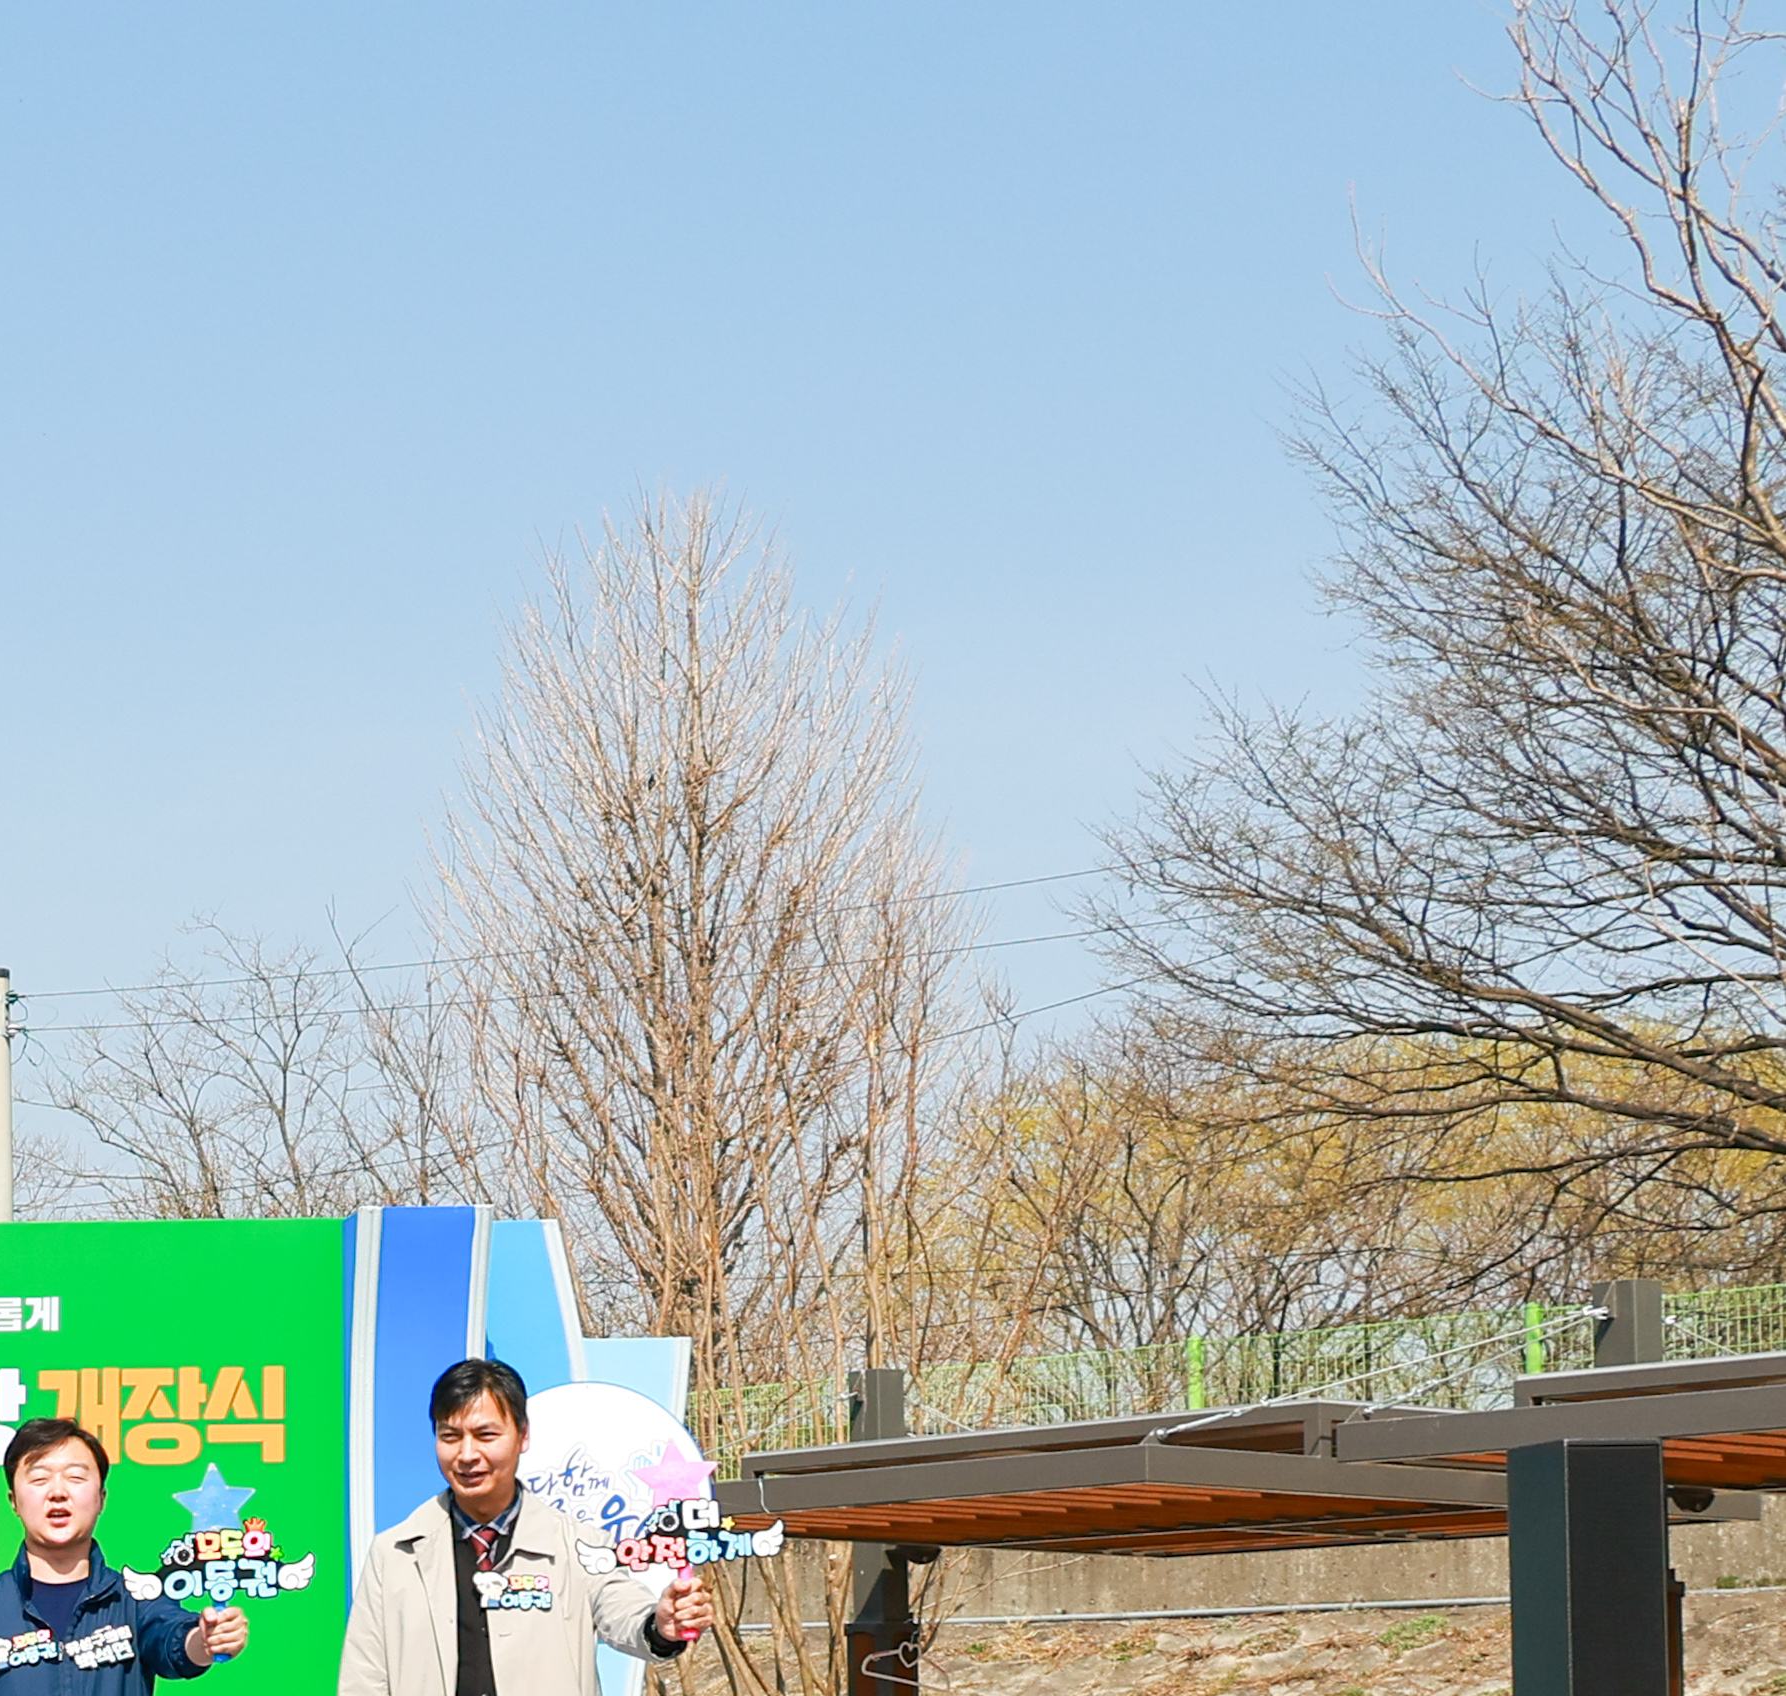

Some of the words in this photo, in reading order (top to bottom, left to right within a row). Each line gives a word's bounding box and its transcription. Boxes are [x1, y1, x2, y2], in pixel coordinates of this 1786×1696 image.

[37, 1365, 286, 1466] 개장식
[682, 1498, 720, 1529] 더
[195, 1529, 272, 1560] 모두의
[615, 1530, 753, 1572] 안전하게
[163, 1559, 279, 1601] 이동권
